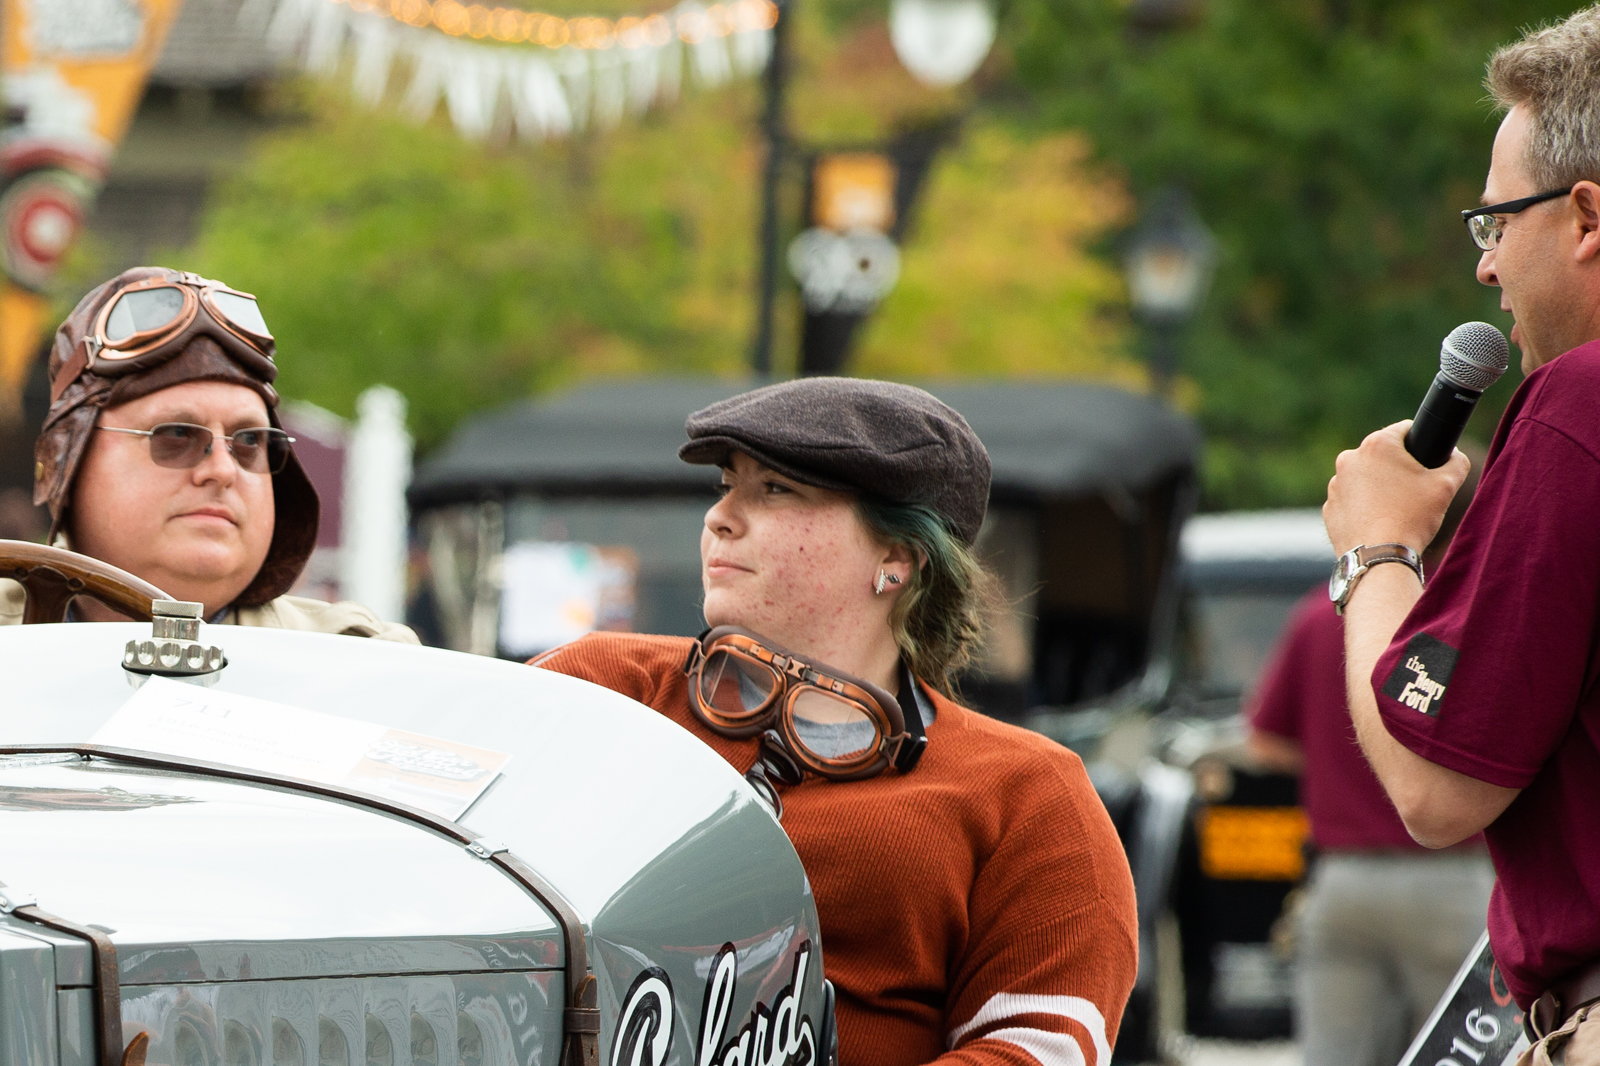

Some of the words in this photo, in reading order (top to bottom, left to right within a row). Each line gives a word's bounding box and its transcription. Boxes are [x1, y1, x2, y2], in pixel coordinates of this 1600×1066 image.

[1405, 655, 1425, 674] the
[1397, 681, 1433, 714] Ford
[1414, 670, 1446, 701] Henry
[172, 697, 233, 720] 711
